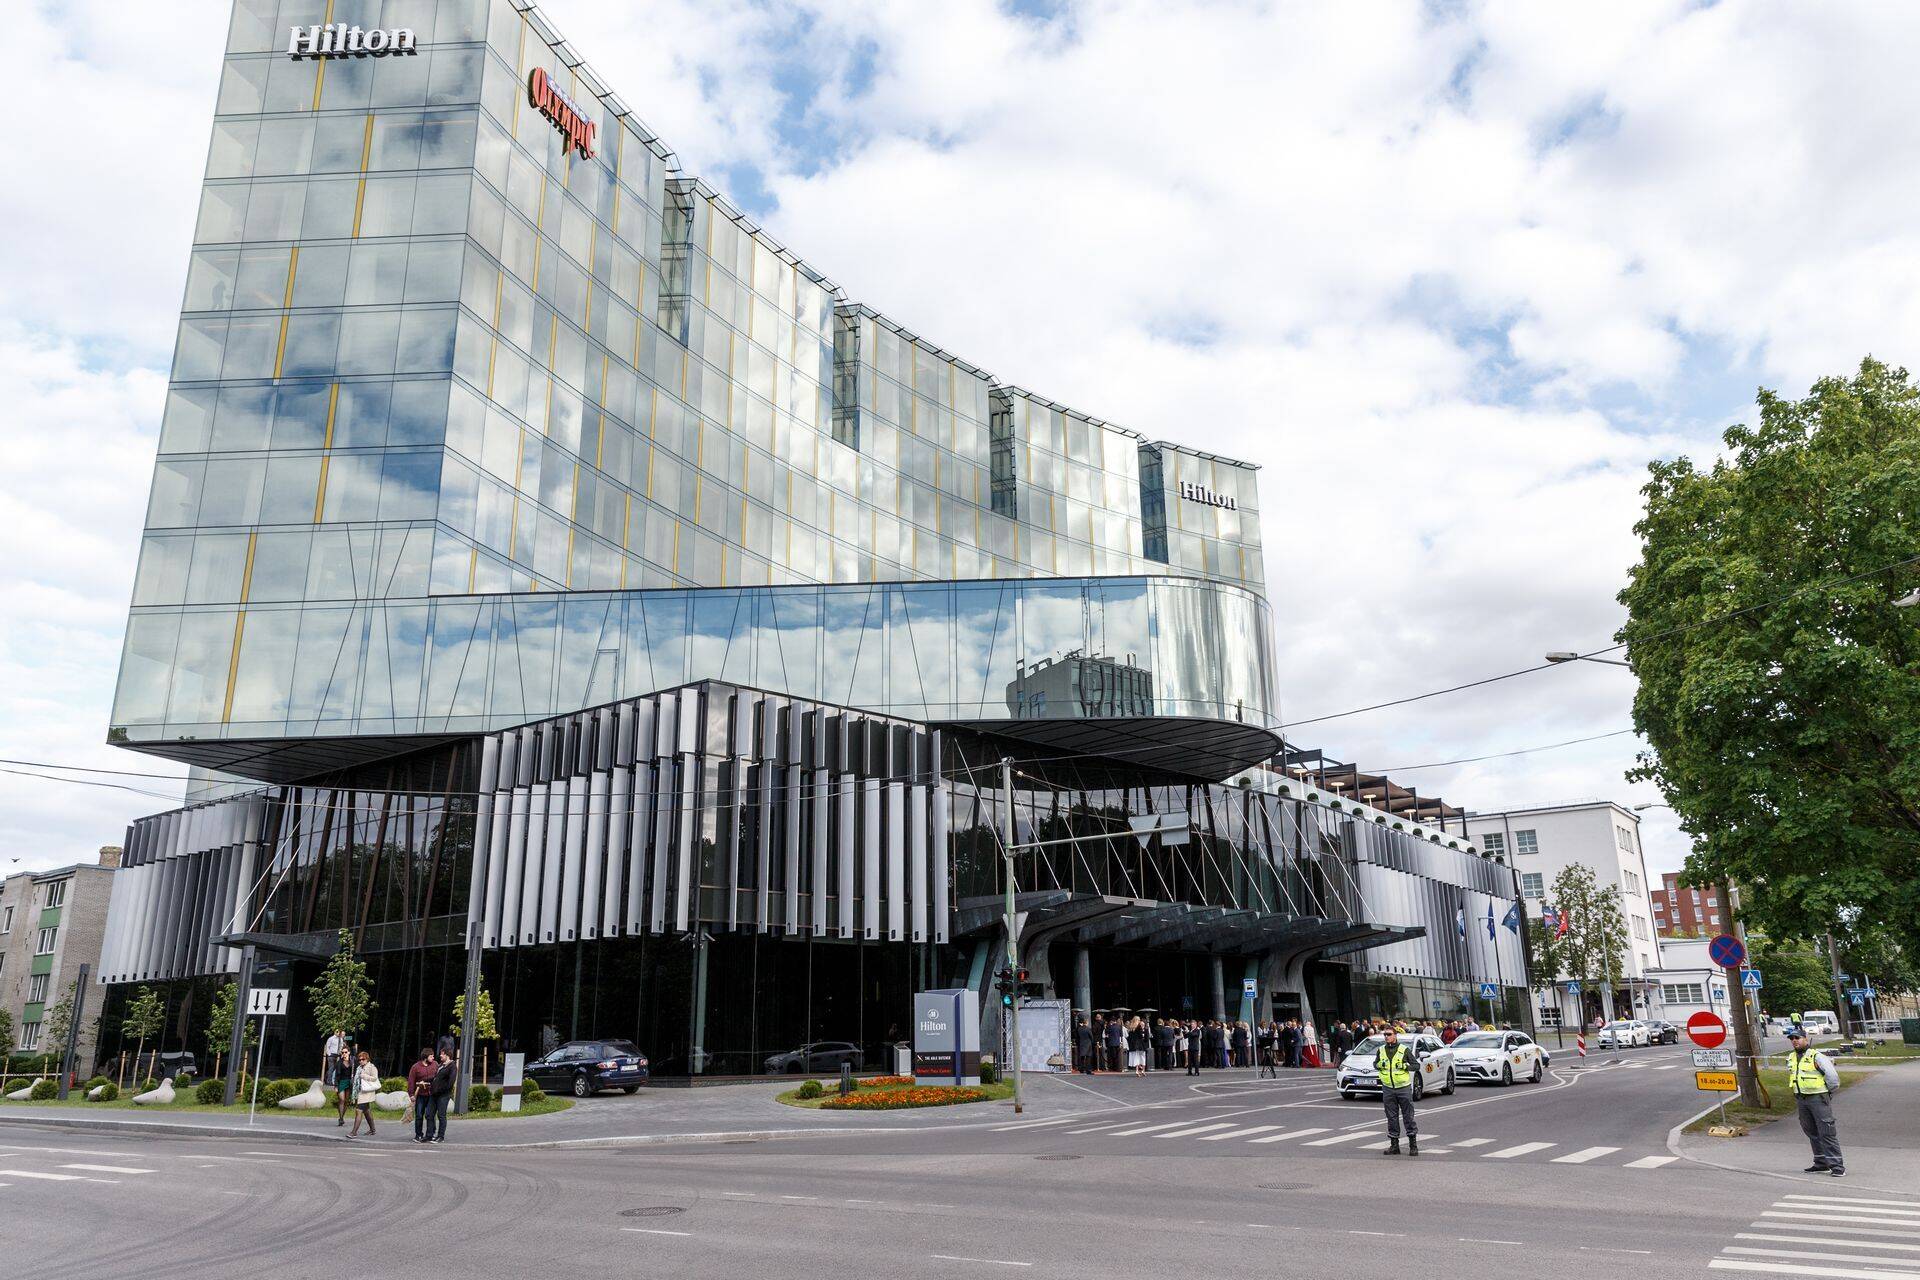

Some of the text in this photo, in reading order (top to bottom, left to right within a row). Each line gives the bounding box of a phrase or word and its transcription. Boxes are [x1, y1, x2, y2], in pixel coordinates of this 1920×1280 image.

[287, 22, 416, 57] Hilton
[547, 77, 589, 125] CASINO
[1180, 480, 1238, 510] Hilton
[920, 1021, 947, 1031] Hilton
